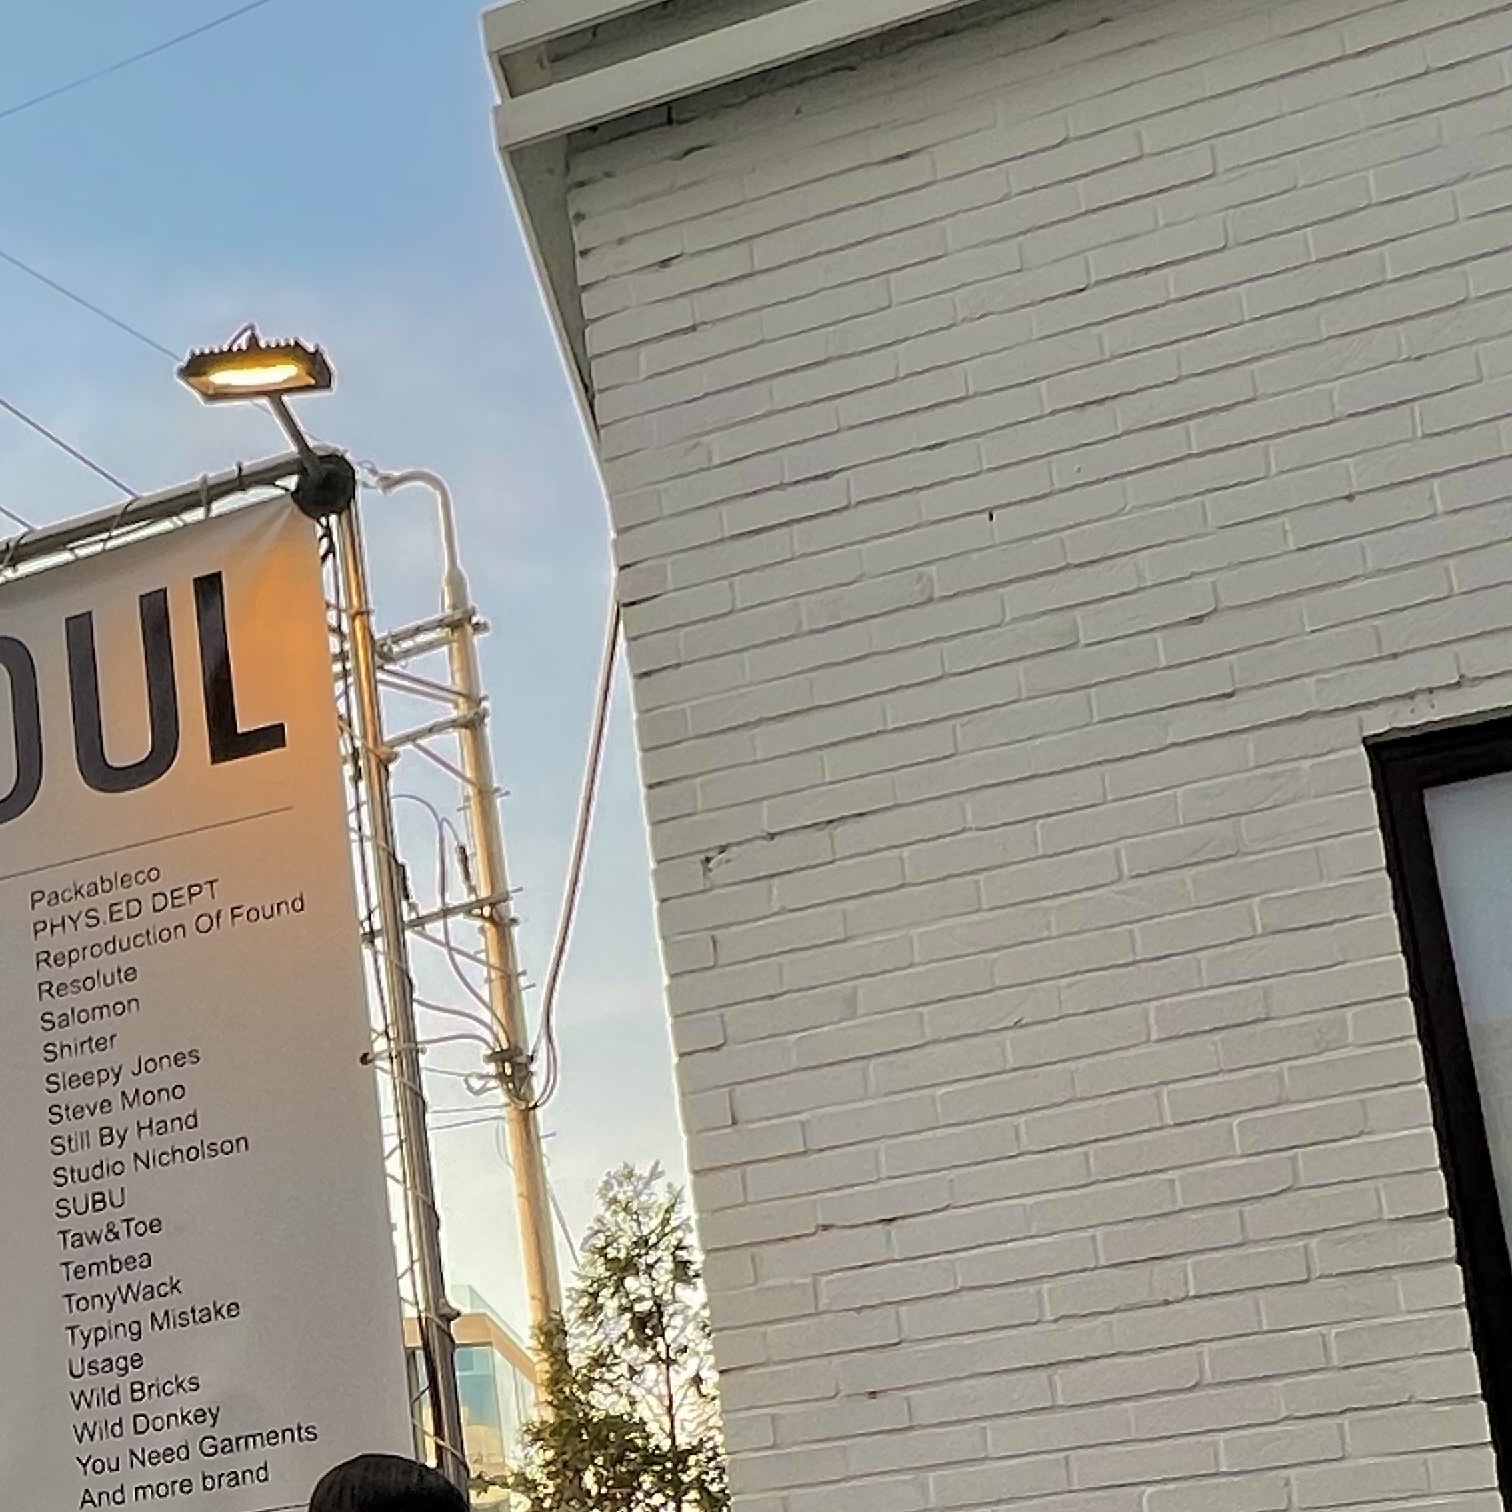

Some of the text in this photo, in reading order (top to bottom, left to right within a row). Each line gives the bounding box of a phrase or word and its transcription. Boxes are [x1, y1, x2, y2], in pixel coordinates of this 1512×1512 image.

[30, 866, 161, 911] Packableco
[32, 879, 220, 941] PHYS.ED DEPT
[35, 891, 306, 972] Reproduction Of Found
[37, 966, 139, 1002] Resolute
[40, 997, 140, 1032] Salomon
[42, 1032, 118, 1064] Shirter
[45, 1047, 201, 1094] Sleepy Jones
[48, 1083, 186, 1126] Steve Mono
[50, 1109, 199, 1157] Still By Hand
[52, 1135, 250, 1189] Studio Nicholson
[54, 1187, 126, 1220] SUBU
[57, 1216, 163, 1251] Taw&Toe
[59, 1251, 152, 1282] Tembea
[61, 1275, 184, 1315] TonyWack
[65, 1299, 241, 1350] Typing Mistake
[68, 1352, 145, 1380] Usage
[69, 1374, 201, 1412] Wild Bricks
[72, 1405, 221, 1445] Wild Donkey
[76, 1423, 318, 1478] You Need Garments
[79, 1462, 271, 1510] And more brand
